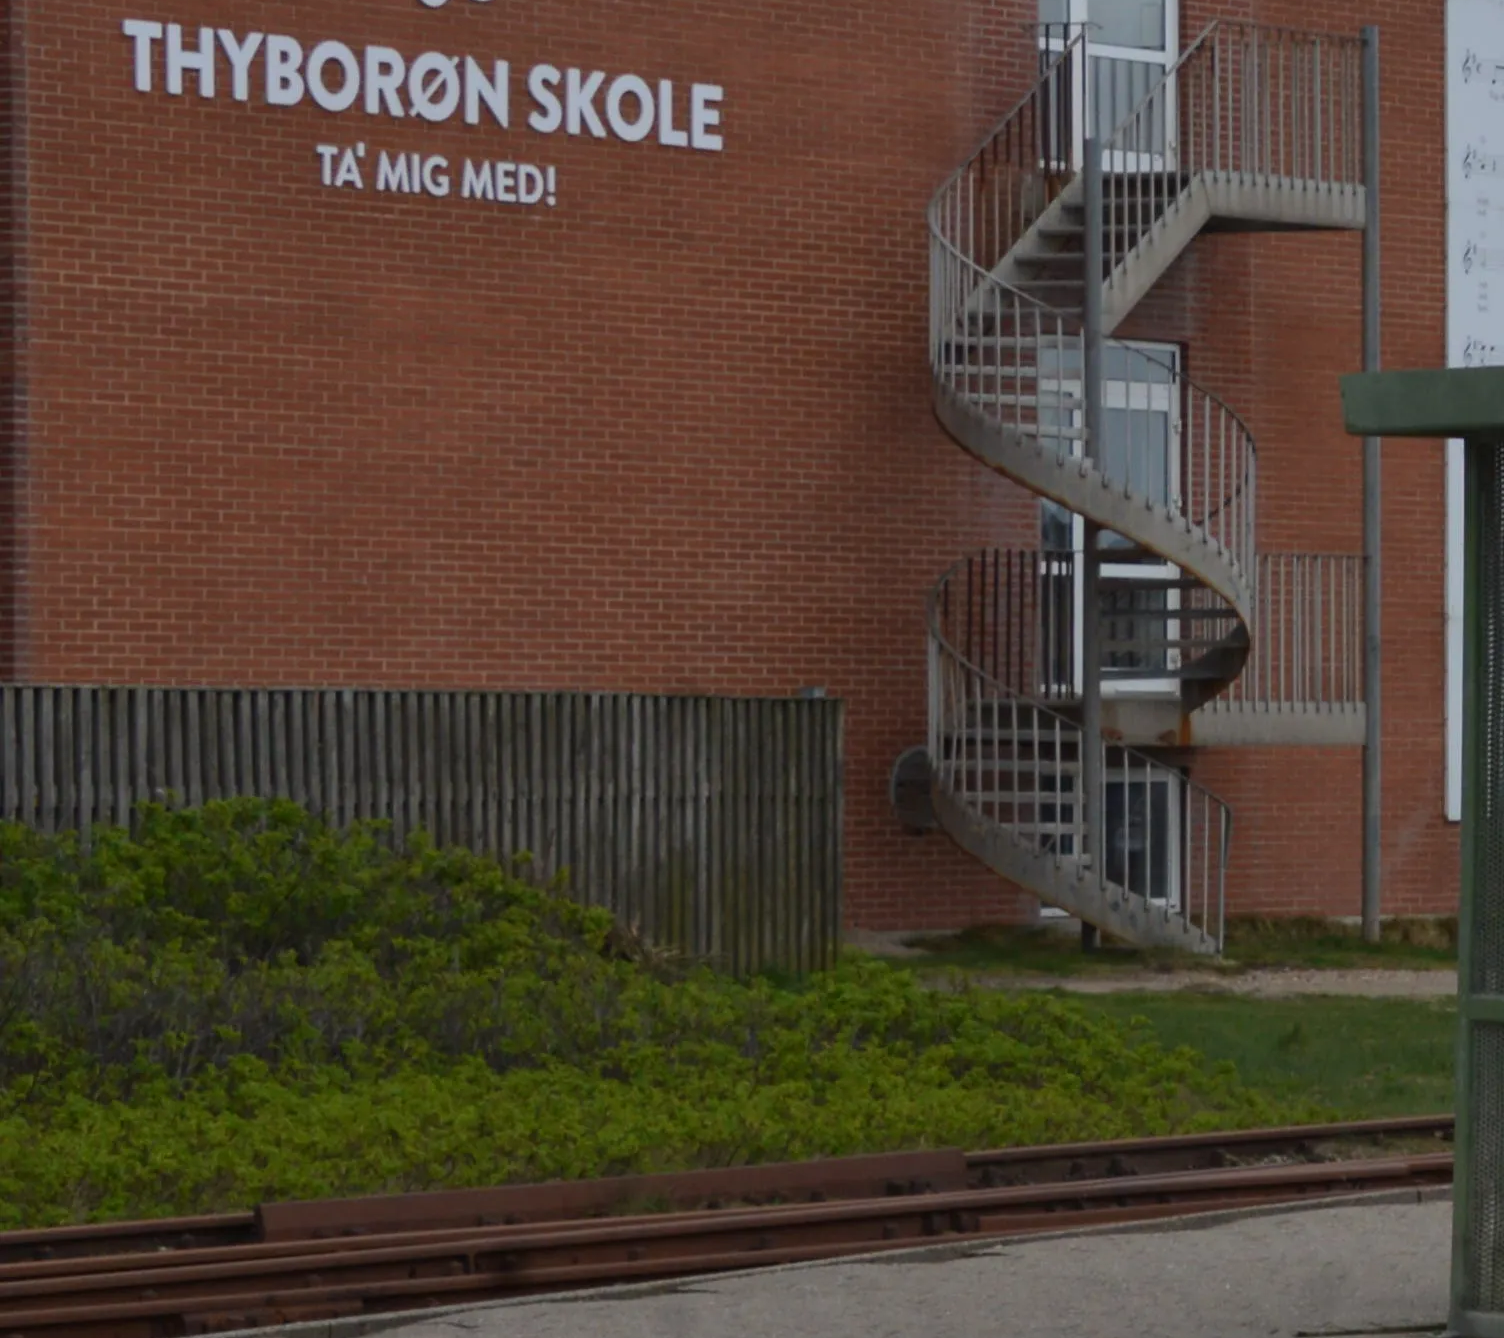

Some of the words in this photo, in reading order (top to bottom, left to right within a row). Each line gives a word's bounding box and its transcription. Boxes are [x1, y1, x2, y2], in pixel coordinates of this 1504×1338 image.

[122, 19, 509, 128] THYBORØN
[527, 64, 724, 151] SKOLE
[376, 151, 450, 197] MIG
[461, 162, 557, 207] MED!
